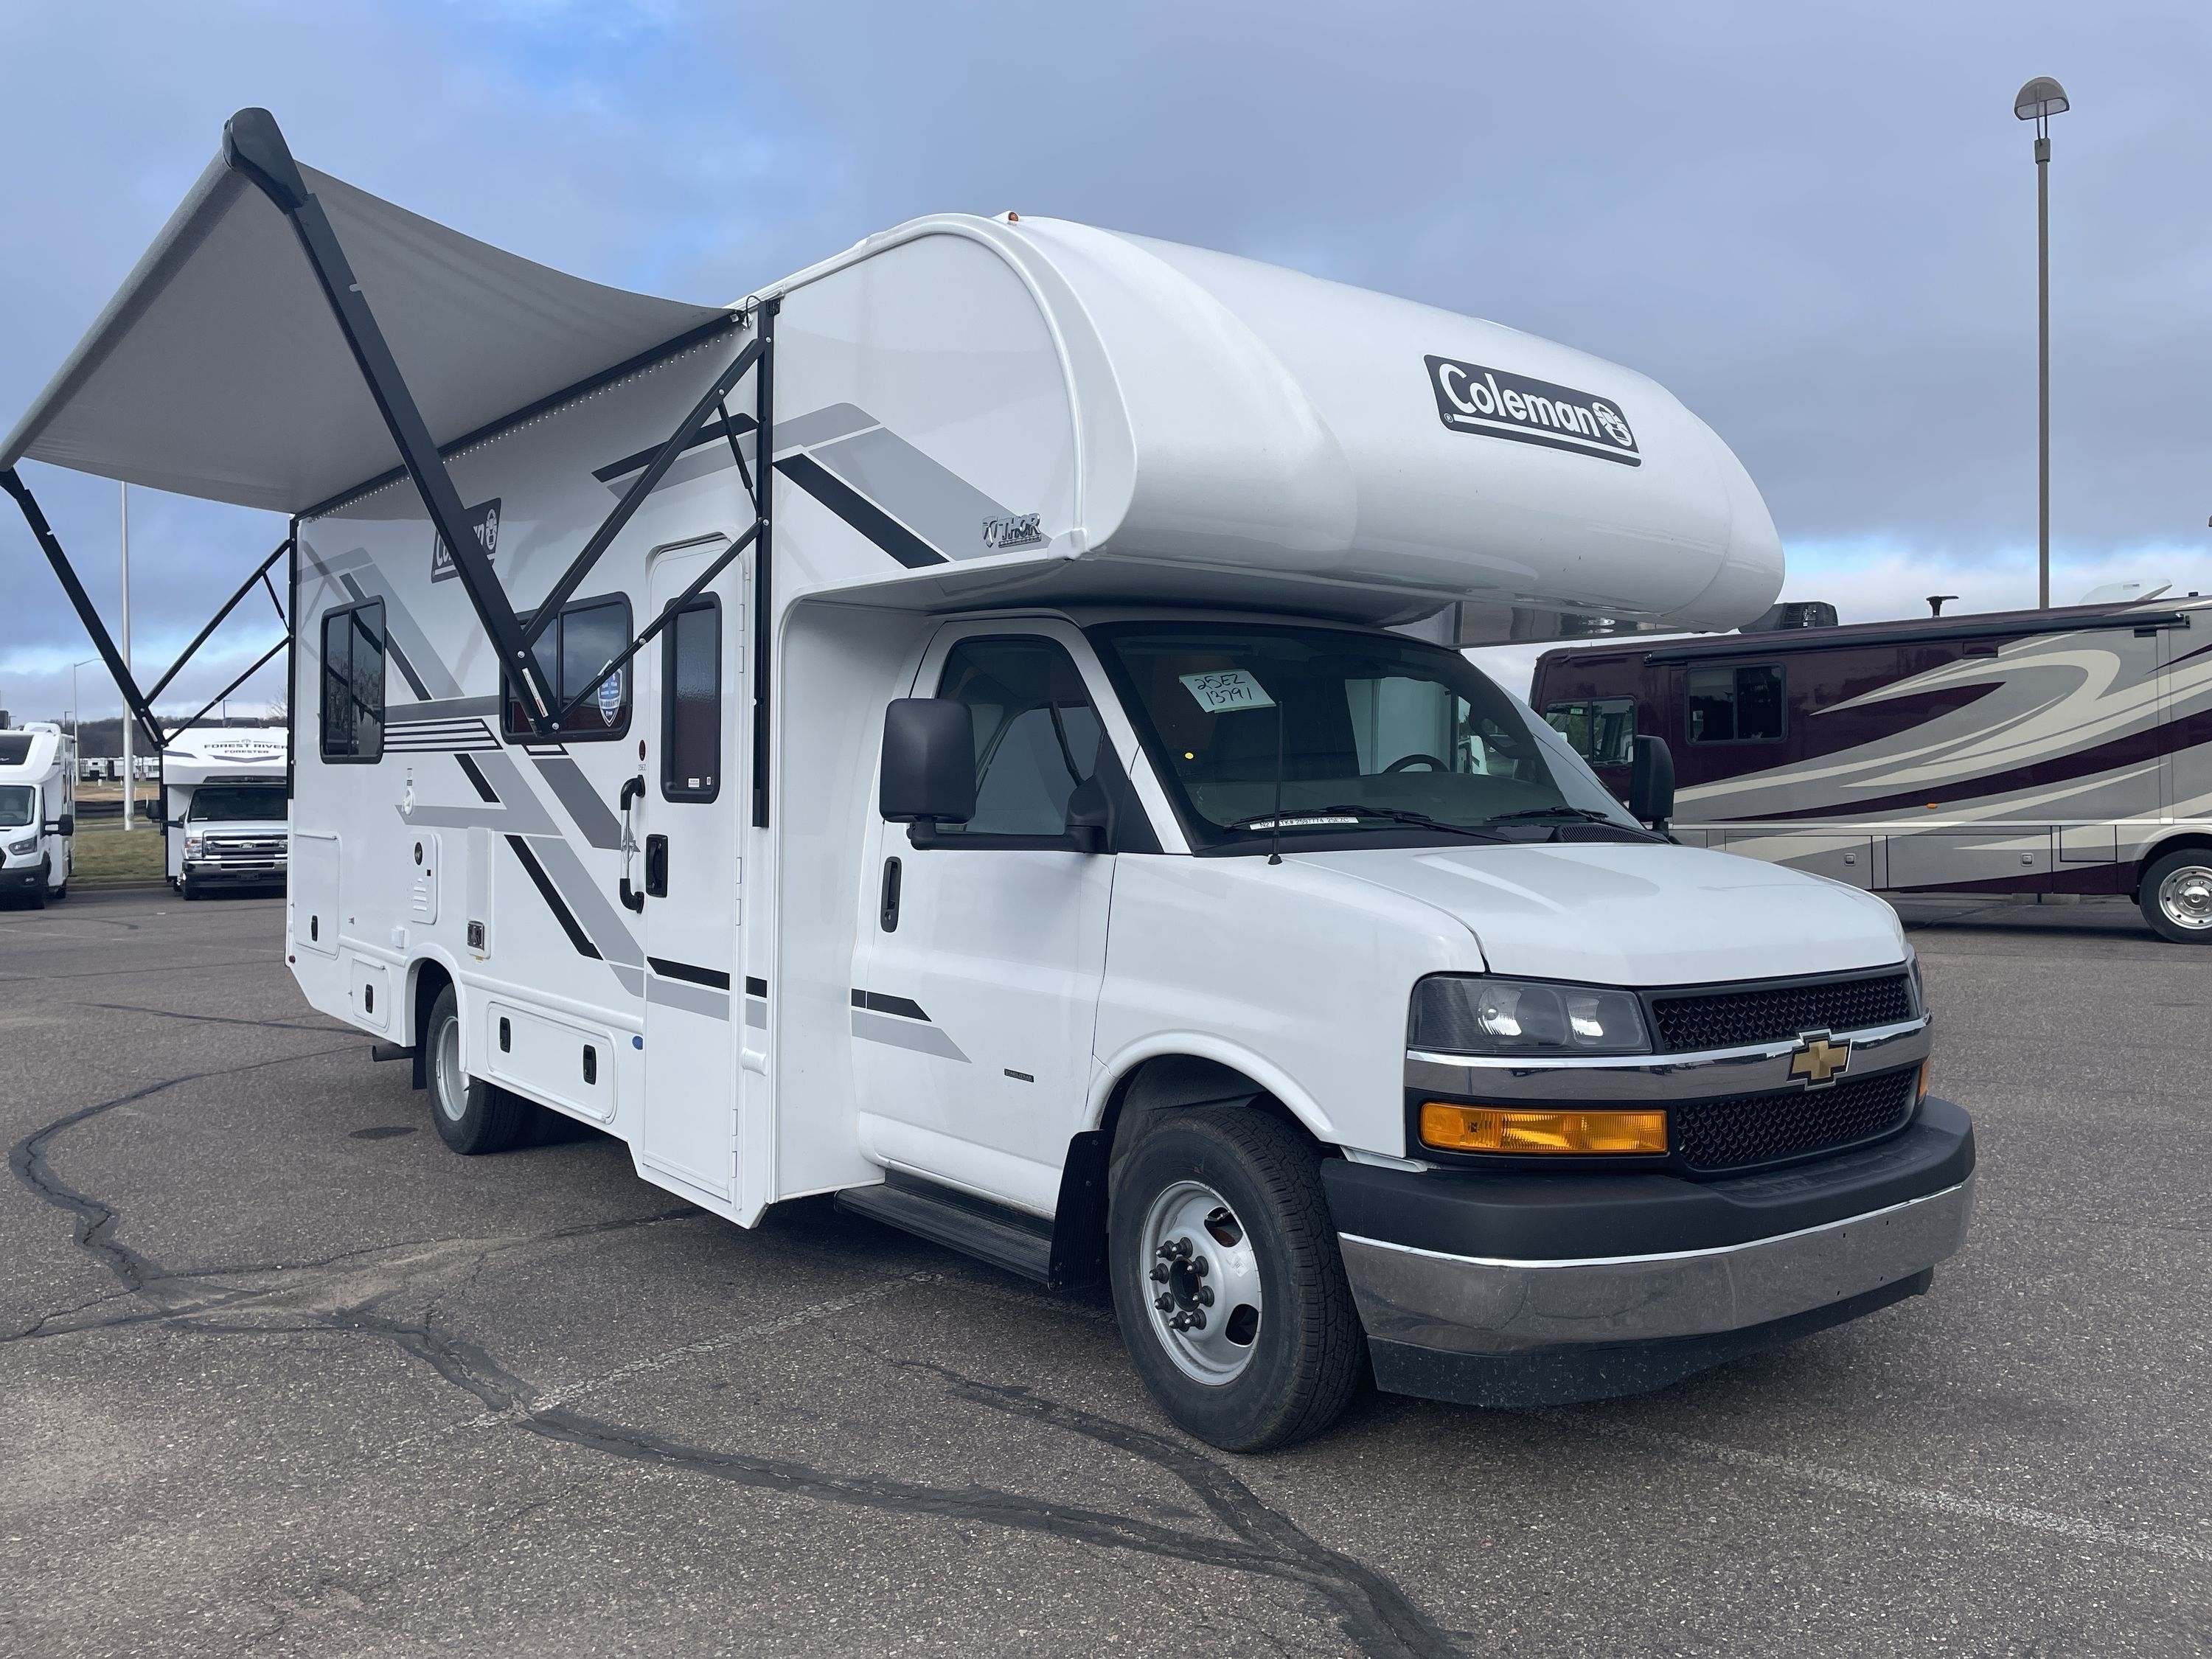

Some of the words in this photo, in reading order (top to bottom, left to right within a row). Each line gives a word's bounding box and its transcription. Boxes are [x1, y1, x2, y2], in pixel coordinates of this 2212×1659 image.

[1439, 364, 1601, 438] Coleman
[998, 513, 1041, 540] THOR
[1206, 686, 1253, 706] 13791
